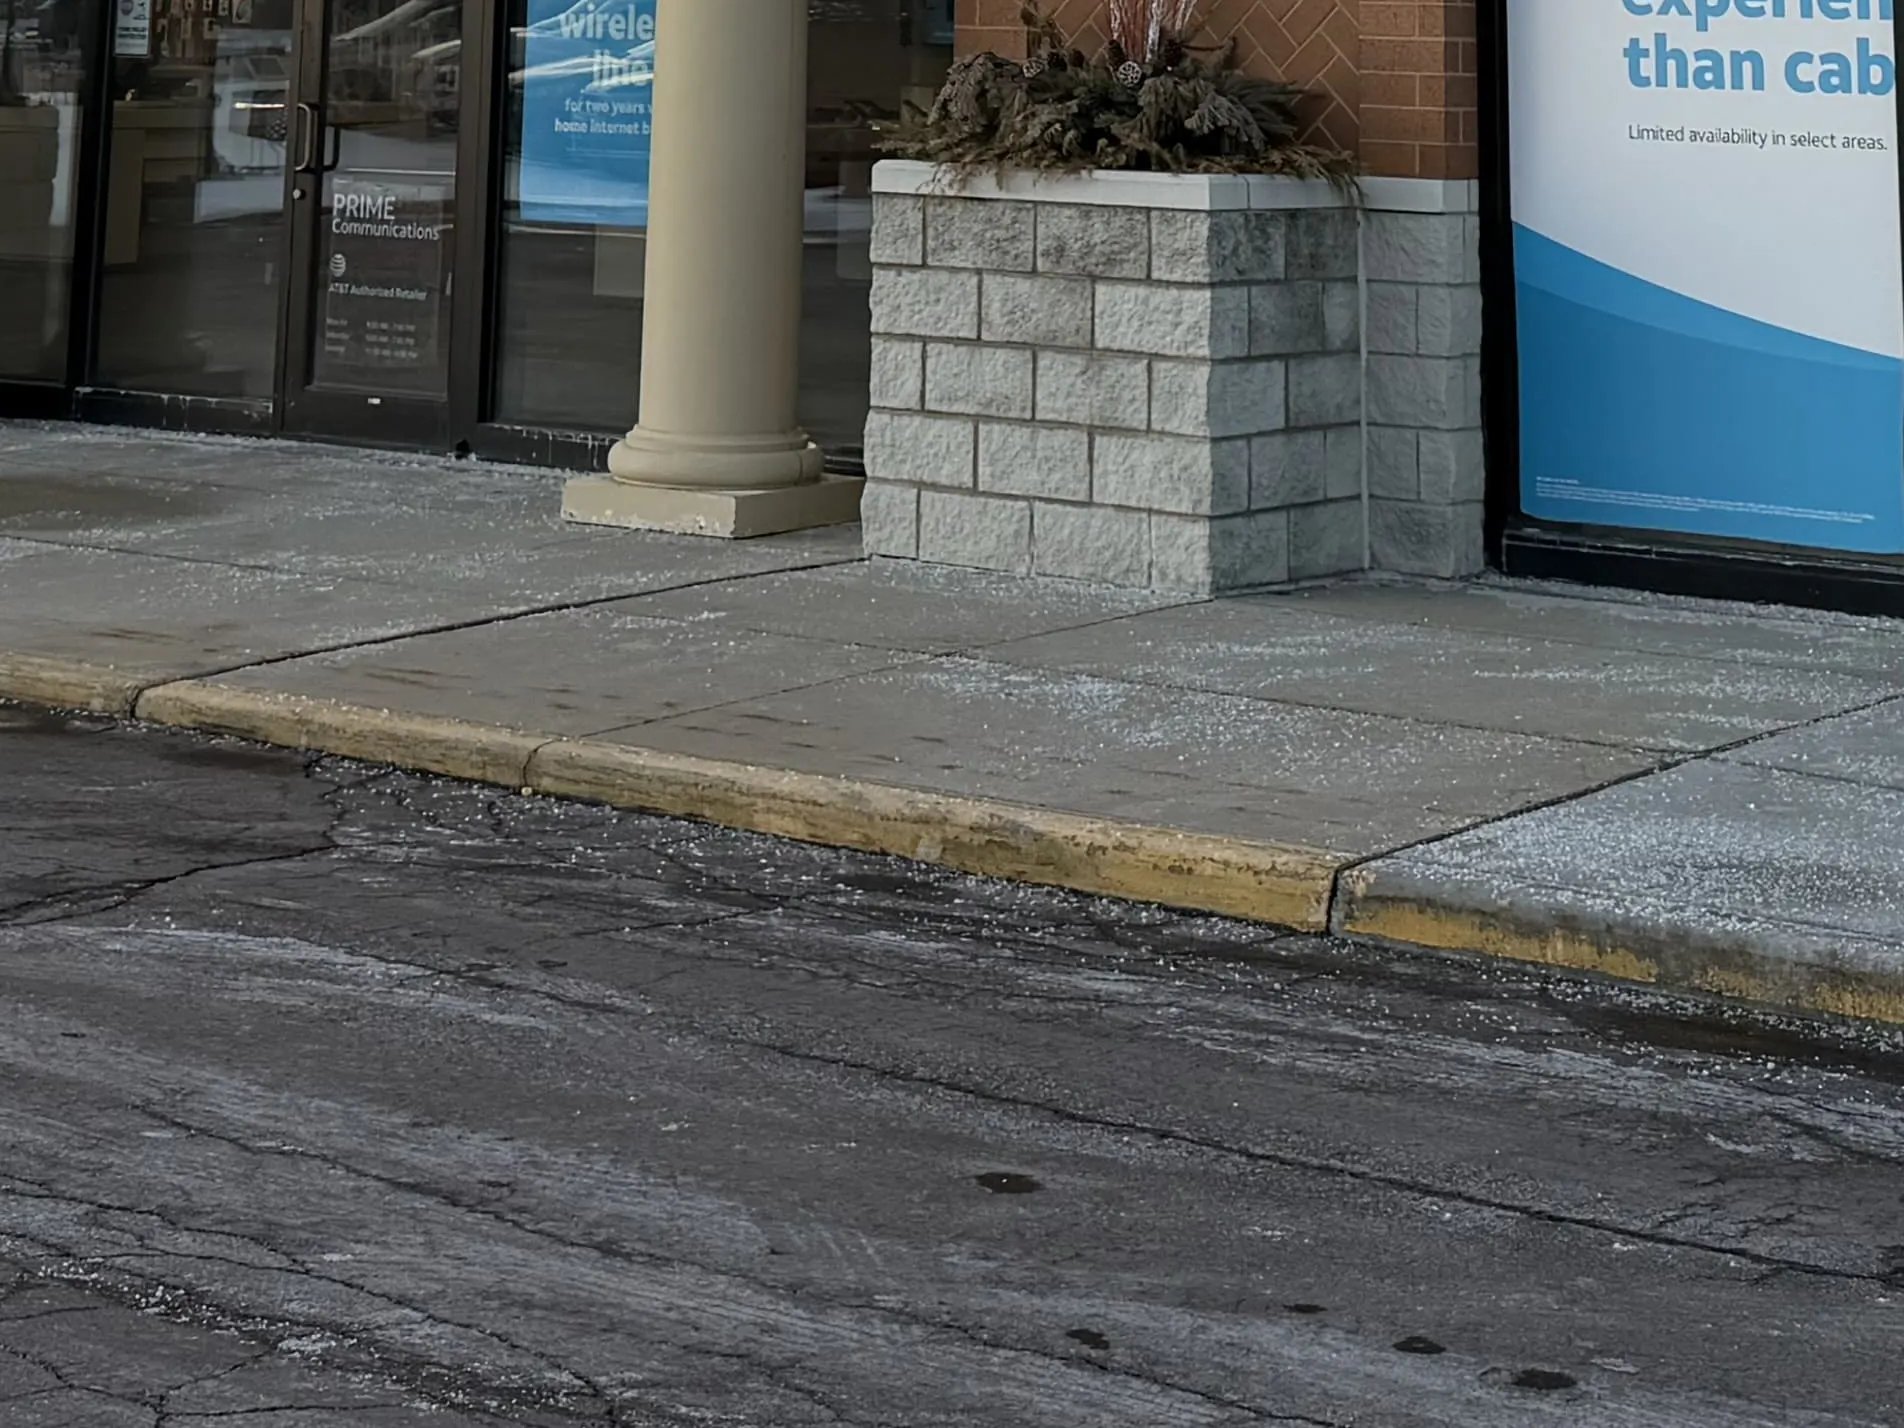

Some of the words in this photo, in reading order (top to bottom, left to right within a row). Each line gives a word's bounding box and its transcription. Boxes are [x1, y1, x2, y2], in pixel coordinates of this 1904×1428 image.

[559, 3, 655, 41] wirele
[593, 48, 649, 87] line
[1623, 32, 1765, 92] than
[564, 98, 583, 112] for
[585, 99, 609, 114] two
[611, 101, 645, 116] years
[554, 117, 588, 133] home
[1628, 124, 1684, 142] Limited
[1689, 127, 1768, 149] availability
[1771, 130, 1786, 146] in
[1790, 131, 1836, 149] select
[1842, 134, 1888, 151] areas.
[332, 193, 396, 220] PRIME
[332, 218, 440, 241] Communications
